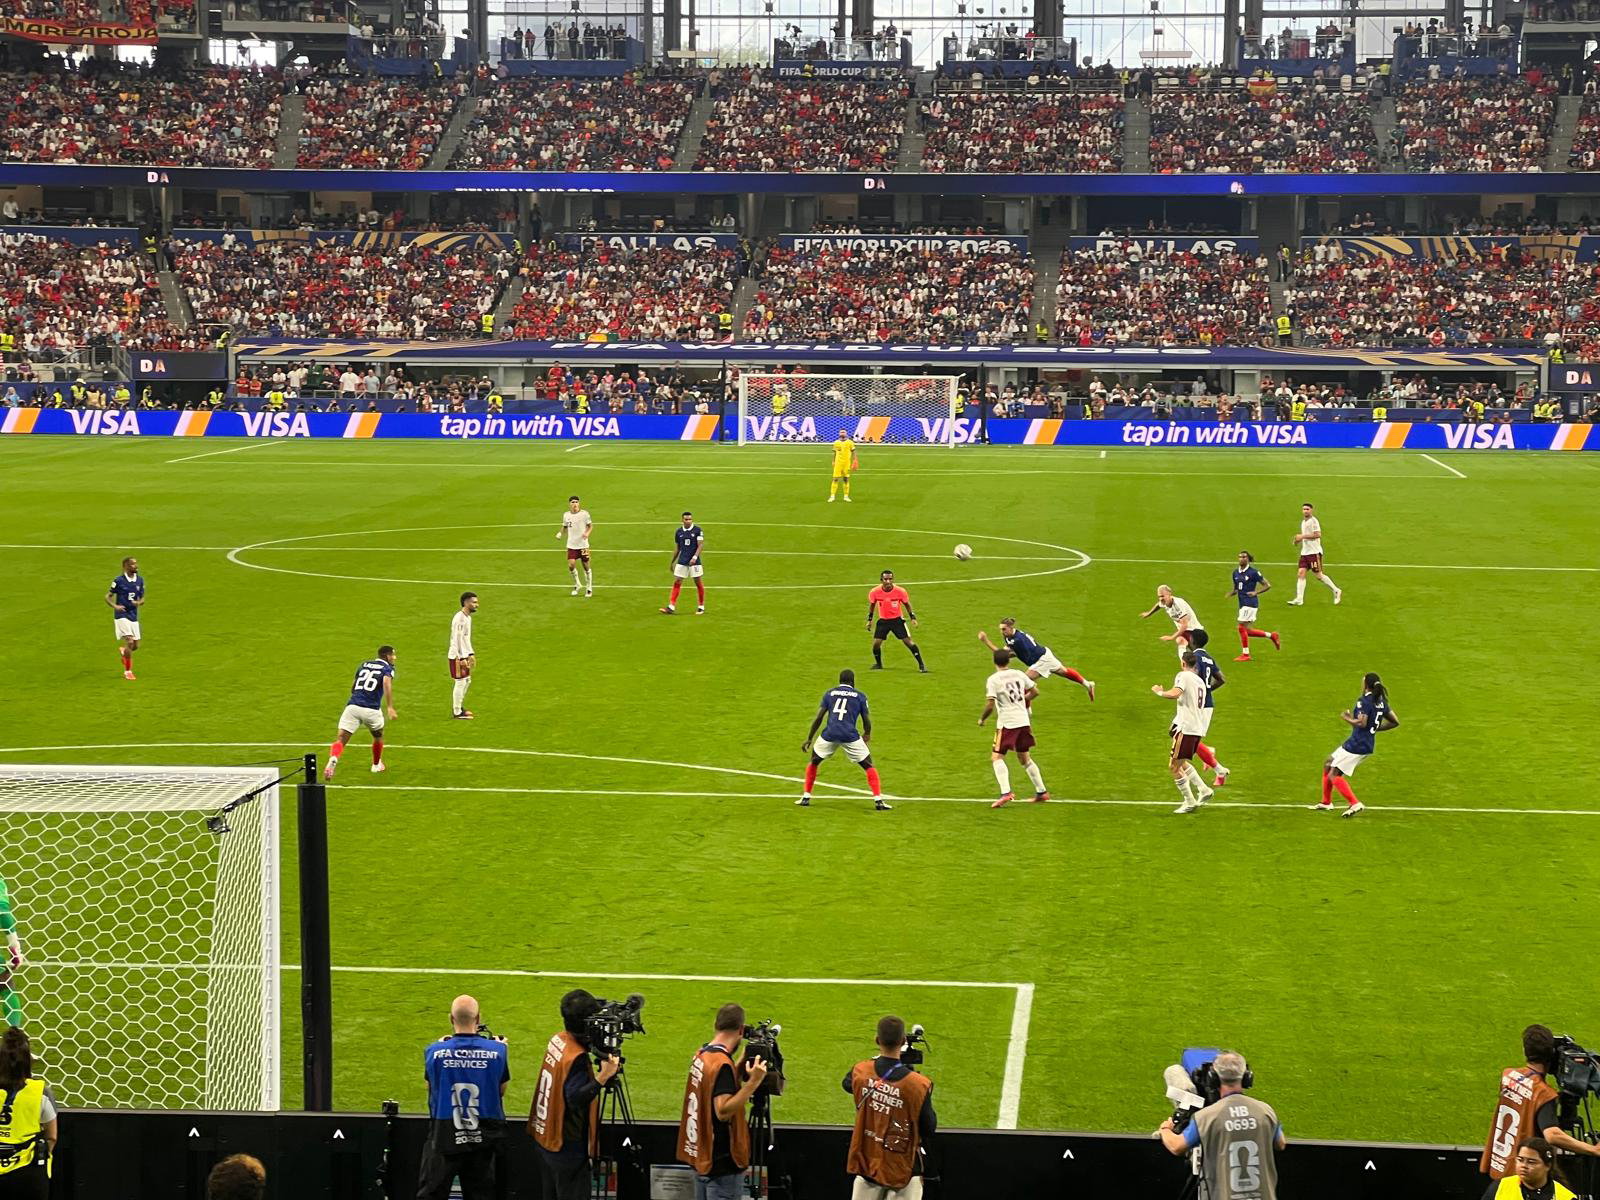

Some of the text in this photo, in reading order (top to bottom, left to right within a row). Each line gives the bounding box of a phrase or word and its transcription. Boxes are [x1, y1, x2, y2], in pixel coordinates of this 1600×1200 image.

[779, 67, 801, 76] FIFA
[840, 67, 862, 76] CUP
[794, 238, 832, 252] FIFA
[681, 343, 883, 351] WORLD
[64, 409, 140, 435] VISA
[236, 411, 311, 437] VISA
[440, 414, 621, 439] tap in with VISA
[745, 415, 817, 441] VISA
[915, 417, 989, 443] VISA
[1122, 421, 1307, 447] tap in with VISA
[1437, 423, 1516, 449] VISA
[354, 669, 382, 692] 26
[832, 697, 848, 721] 4
[1369, 711, 1384, 735] 5
[433, 1049, 499, 1059] FIFA CONTENT
[442, 1060, 488, 1069] SERVICES
[868, 1078, 900, 1098] MEDIA
[1229, 1106, 1249, 1118] HB
[1224, 1118, 1257, 1132] 0693
